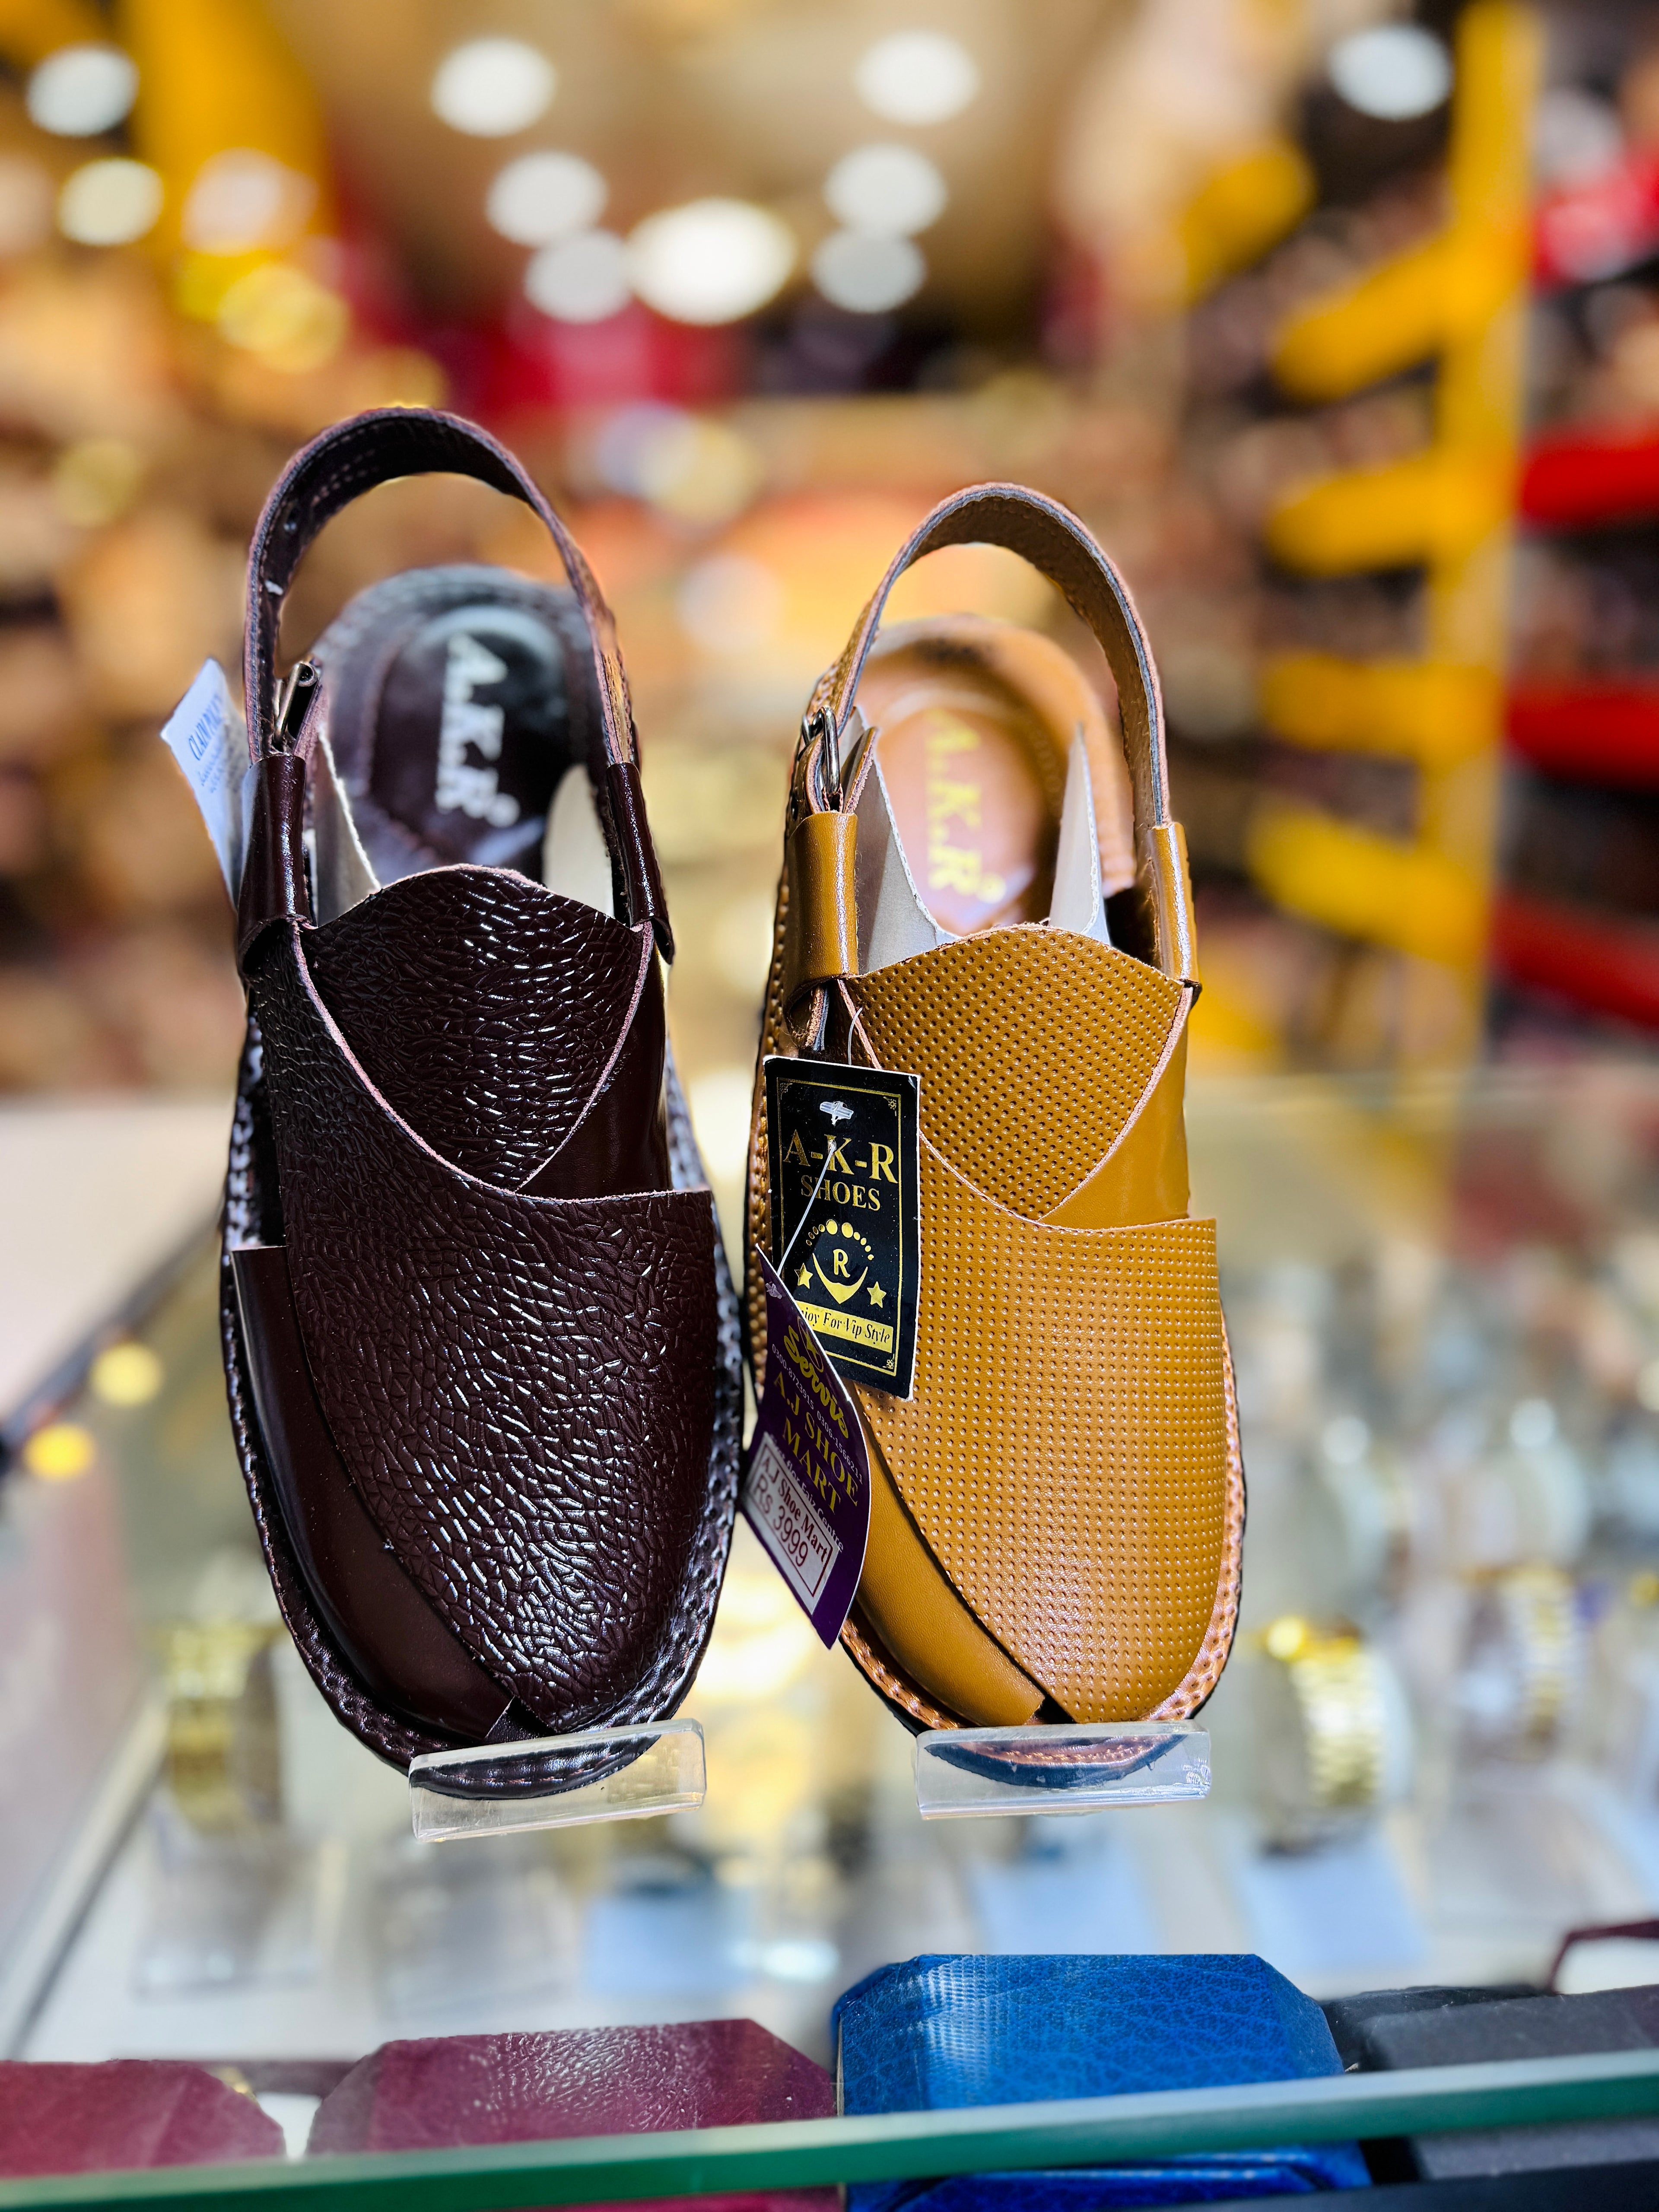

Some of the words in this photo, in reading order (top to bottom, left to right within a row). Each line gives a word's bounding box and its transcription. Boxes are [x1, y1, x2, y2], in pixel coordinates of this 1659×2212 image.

[783, 1129, 898, 1184] A-K-R
[801, 1175, 880, 1211] SHOES
[833, 1249, 851, 1278] R
[823, 1312, 842, 1330] For
[846, 1318, 862, 1339] Vip
[865, 1324, 890, 1345] Style
[772, 1344, 814, 1410] 0300-8723915
[817, 1410, 863, 1485] 0306-1566211
[784, 1325, 849, 1439] Servis
[773, 1371, 800, 1420] A.J
[805, 1412, 858, 1508] SHOE
[782, 1416, 841, 1516] MART
[773, 1505, 808, 1567] 3999
[779, 1478, 801, 1521] Shoe
[801, 1514, 828, 1564] Mart
